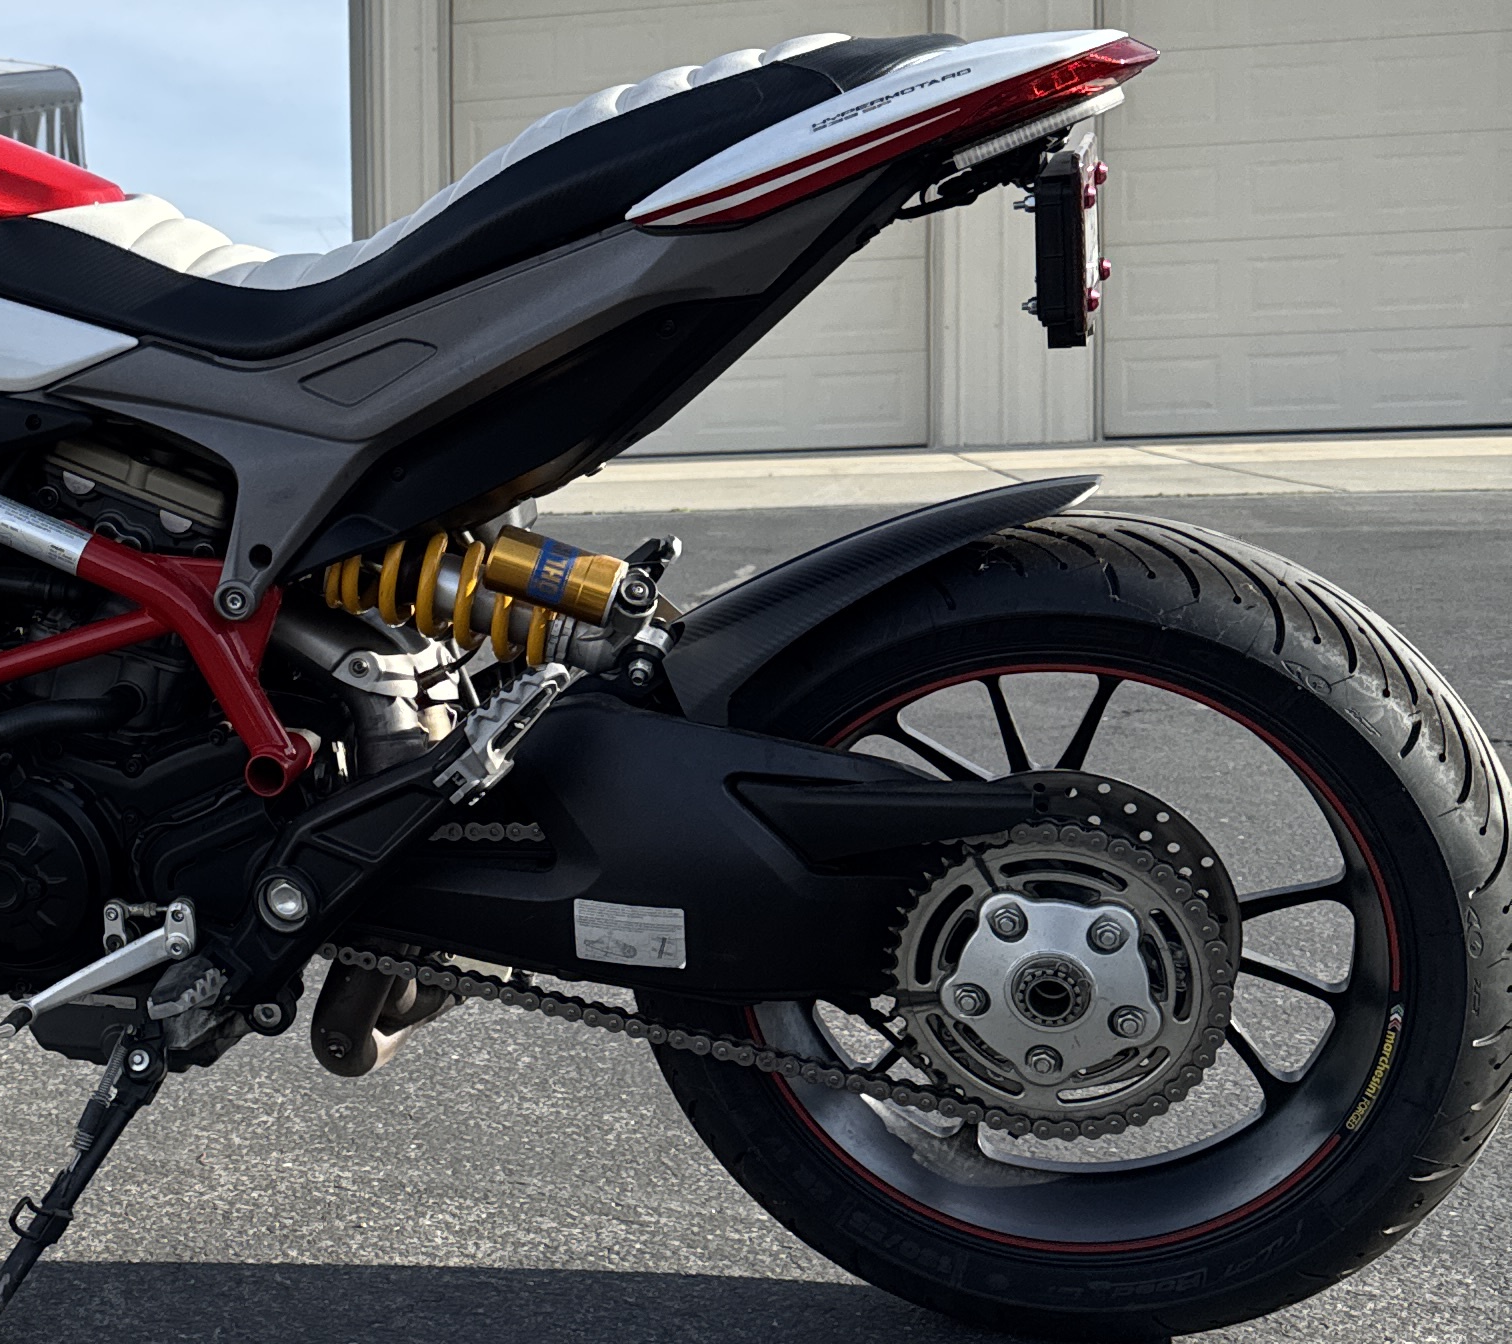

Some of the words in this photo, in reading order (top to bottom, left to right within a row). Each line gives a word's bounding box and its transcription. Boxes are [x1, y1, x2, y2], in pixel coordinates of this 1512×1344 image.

[811, 67, 972, 129] HYPERMOTARD
[1364, 1030, 1397, 1099] marchesini
[1345, 1096, 1371, 1130] FORGED
